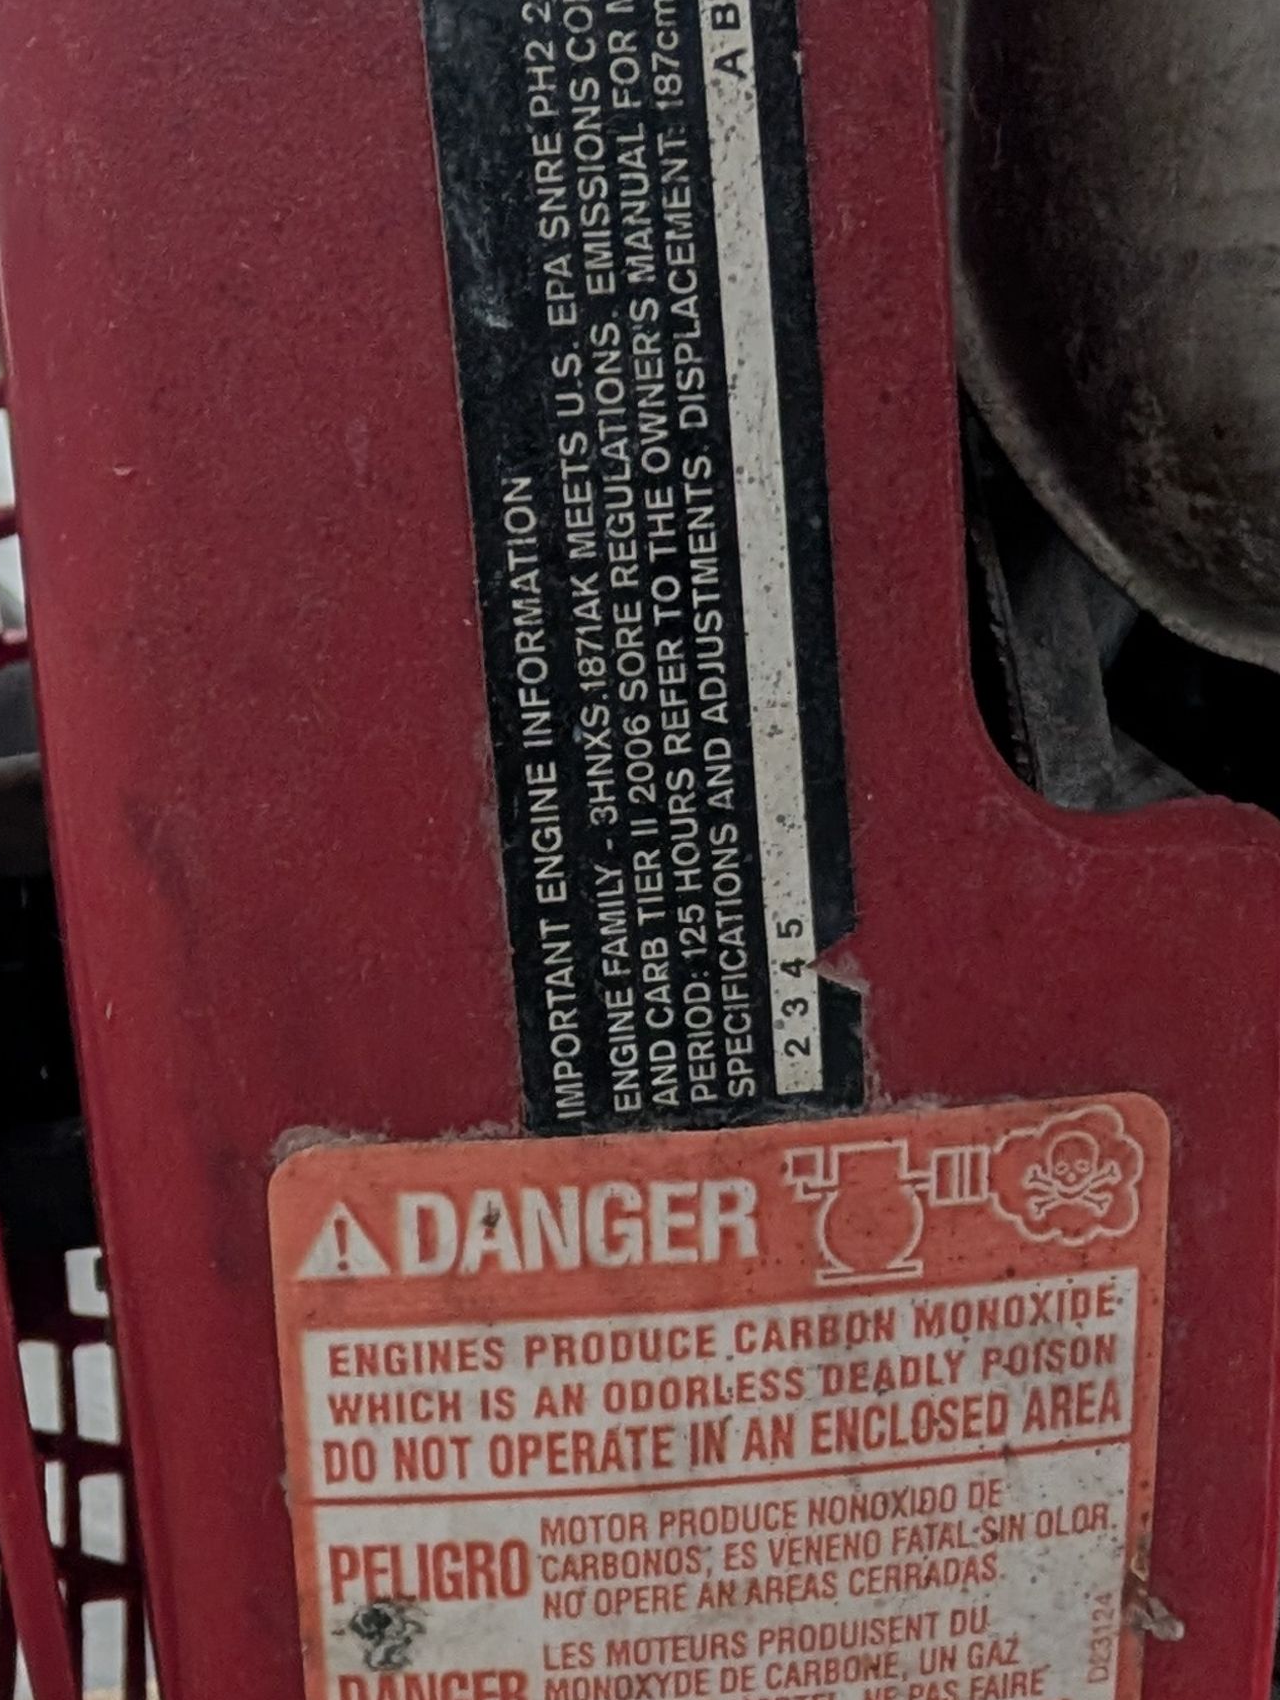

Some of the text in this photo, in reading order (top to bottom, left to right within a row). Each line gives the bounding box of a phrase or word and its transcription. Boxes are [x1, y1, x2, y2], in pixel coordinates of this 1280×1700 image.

[711, 2, 742, 31] B
[525, 41, 558, 116] PH2
[608, 31, 642, 107] FOR
[714, 48, 747, 78] A
[532, 133, 570, 239] SNRE
[570, 78, 618, 294] EMISSIONS
[618, 123, 657, 283] MANUAL
[543, 253, 578, 327] EPA
[657, 126, 709, 429] DISPLACEMENT:
[551, 341, 587, 417] U.S.
[629, 297, 673, 474] OWNER'S
[590, 310, 638, 587] REGULATIONS.
[558, 431, 598, 559] MEETS
[643, 487, 677, 561] THE
[650, 575, 683, 626] TO
[683, 445, 731, 724] ADJUSTMENTS.
[612, 601, 648, 701] SORE
[571, 573, 618, 827] 3HNXS.1871AK
[657, 639, 693, 755] REFER
[502, 477, 587, 1119] IMPORTANT ENGINE INFORMATION
[622, 714, 657, 804] 2006
[704, 737, 736, 809] AND
[630, 817, 659, 836] II
[665, 768, 704, 891] HOURS
[593, 864, 631, 976] FAMILY
[631, 850, 666, 926] TIER
[678, 904, 709, 957] 125
[640, 938, 676, 1028] CARB
[710, 823, 756, 1098] SPECIFICATIONS
[777, 918, 811, 1058] 2 3 4 5
[603, 988, 642, 1111] ENGINE
[649, 1040, 680, 1107] AND
[683, 970, 718, 1102] PERIOD:
[396, 1178, 759, 1277] DANGER
[327, 1283, 1117, 1377] ENGINES PRODUCE CARBON MONOXIDE
[327, 1334, 1118, 1426] WHICH IS AN ODORLESS DEADLY POISON
[323, 1377, 1121, 1484] DO NOT OPERATE IN AN ENCLOSED AREA
[540, 1511, 648, 1546] MOTOR
[659, 1500, 797, 1539] PRODUCE
[967, 1478, 1003, 1511] DE
[723, 1540, 757, 1571] ES
[768, 1528, 881, 1569] VENENO
[891, 1519, 971, 1556] FATAL
[981, 1513, 1026, 1545] SIN
[1034, 1501, 1117, 1538] OLOR.
[328, 1539, 531, 1604] PELIGRO
[542, 1589, 585, 1620] NO
[593, 1582, 688, 1617] OPERE
[696, 1577, 736, 1610] AN
[744, 1570, 838, 1606] AREAS
[542, 1604, 991, 1671] LES MOTEURS PRODUISENT DU
[720, 1661, 756, 1694] DE
[766, 1650, 910, 1691] CARBONE,
[919, 1644, 958, 1676] UN
[966, 1636, 1020, 1670] GAZ
[1087, 1593, 1113, 1684] D23124
